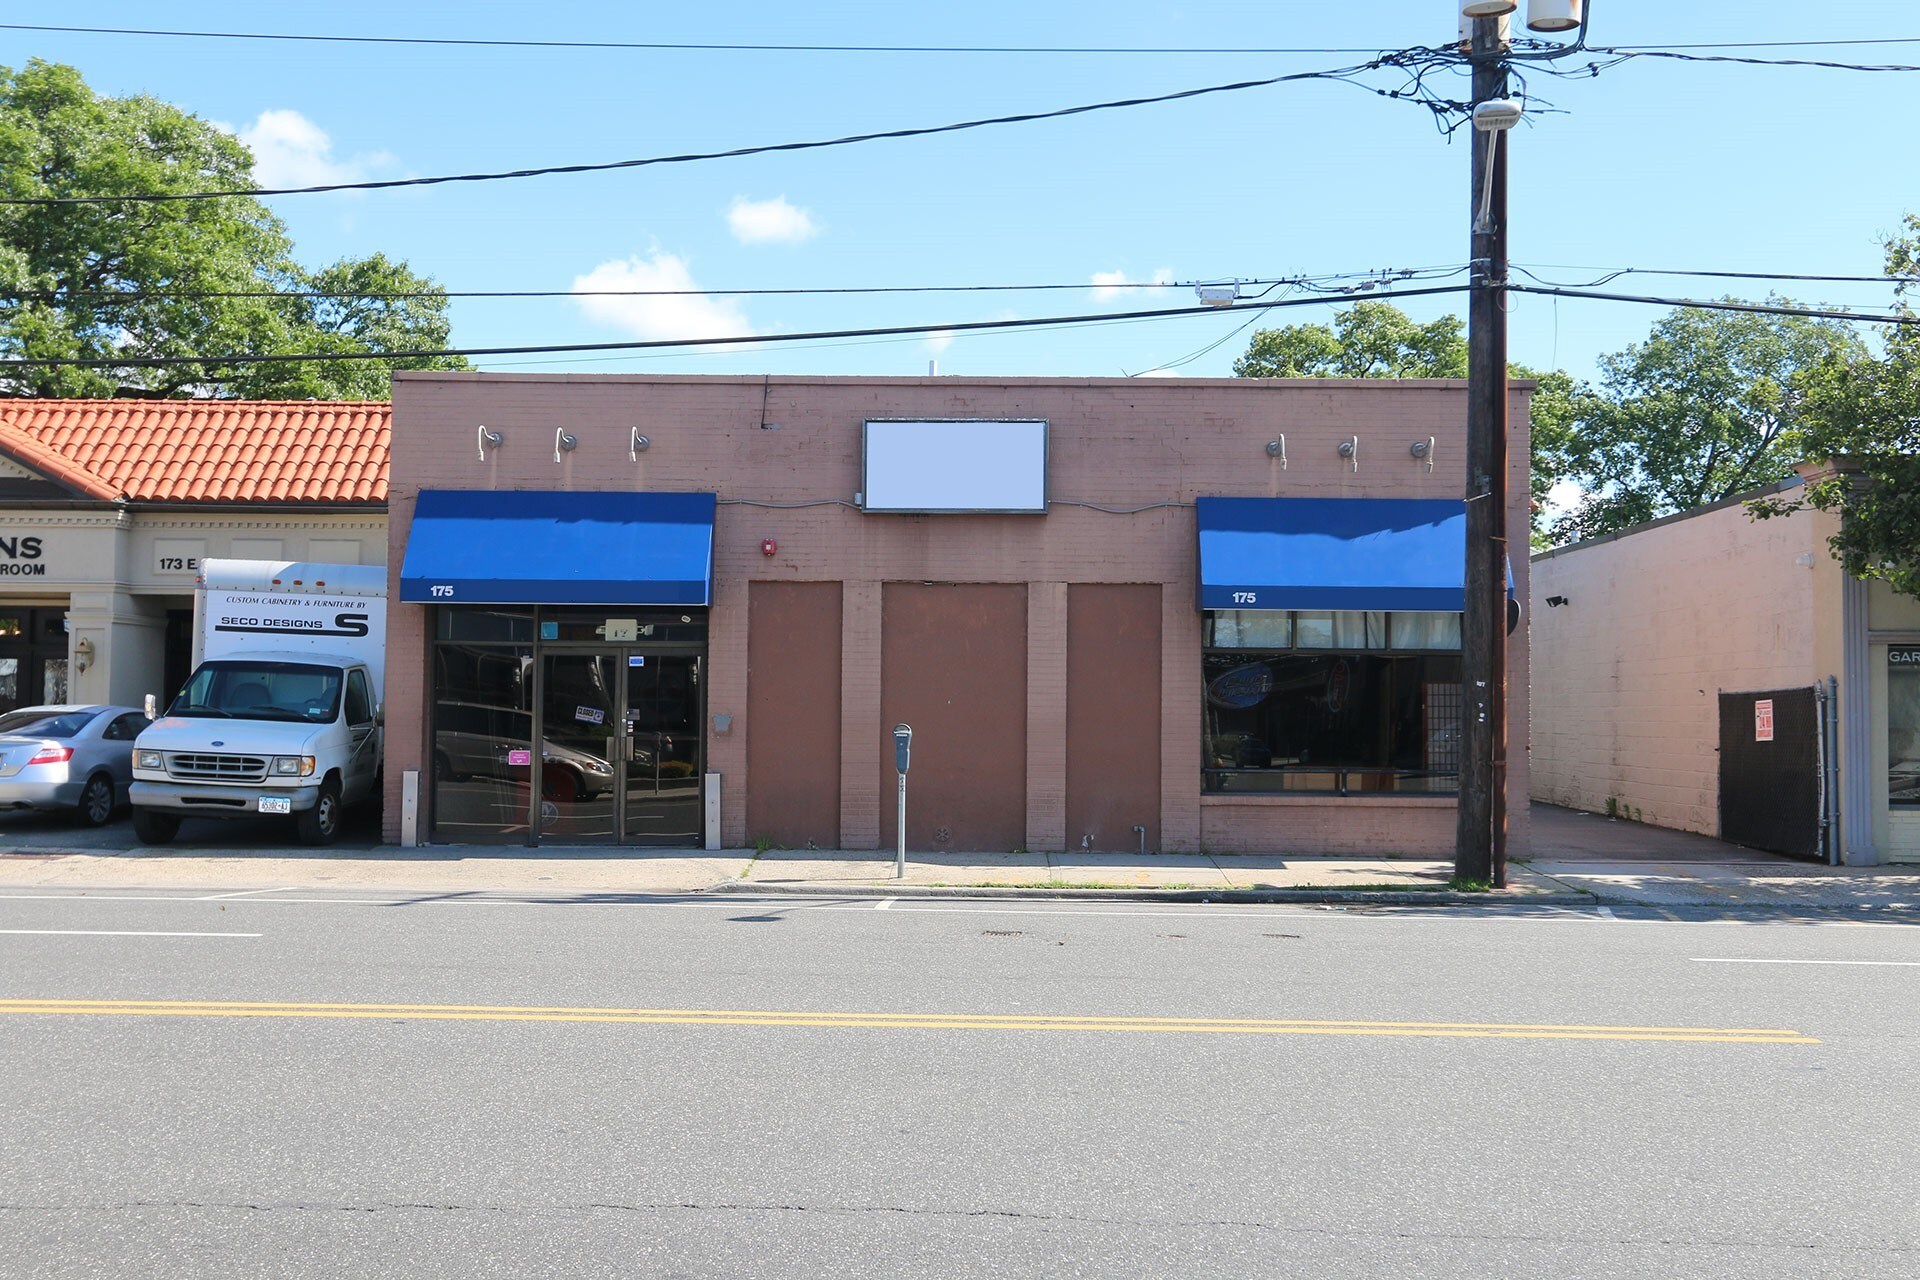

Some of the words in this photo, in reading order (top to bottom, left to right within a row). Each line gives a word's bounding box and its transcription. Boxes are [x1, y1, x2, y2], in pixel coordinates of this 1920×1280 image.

[0, 537, 43, 559] NS
[0, 563, 45, 576] ROOM
[160, 558, 182, 570] 173
[430, 585, 454, 597] 175
[226, 596, 260, 605] CUSTOM
[261, 597, 302, 607] CABINETRY
[313, 600, 354, 609] FURNITURE
[1232, 592, 1256, 603] 175
[221, 616, 258, 626] SECO
[263, 618, 323, 629] DESIGNS
[1888, 651, 1920, 662] GAR
